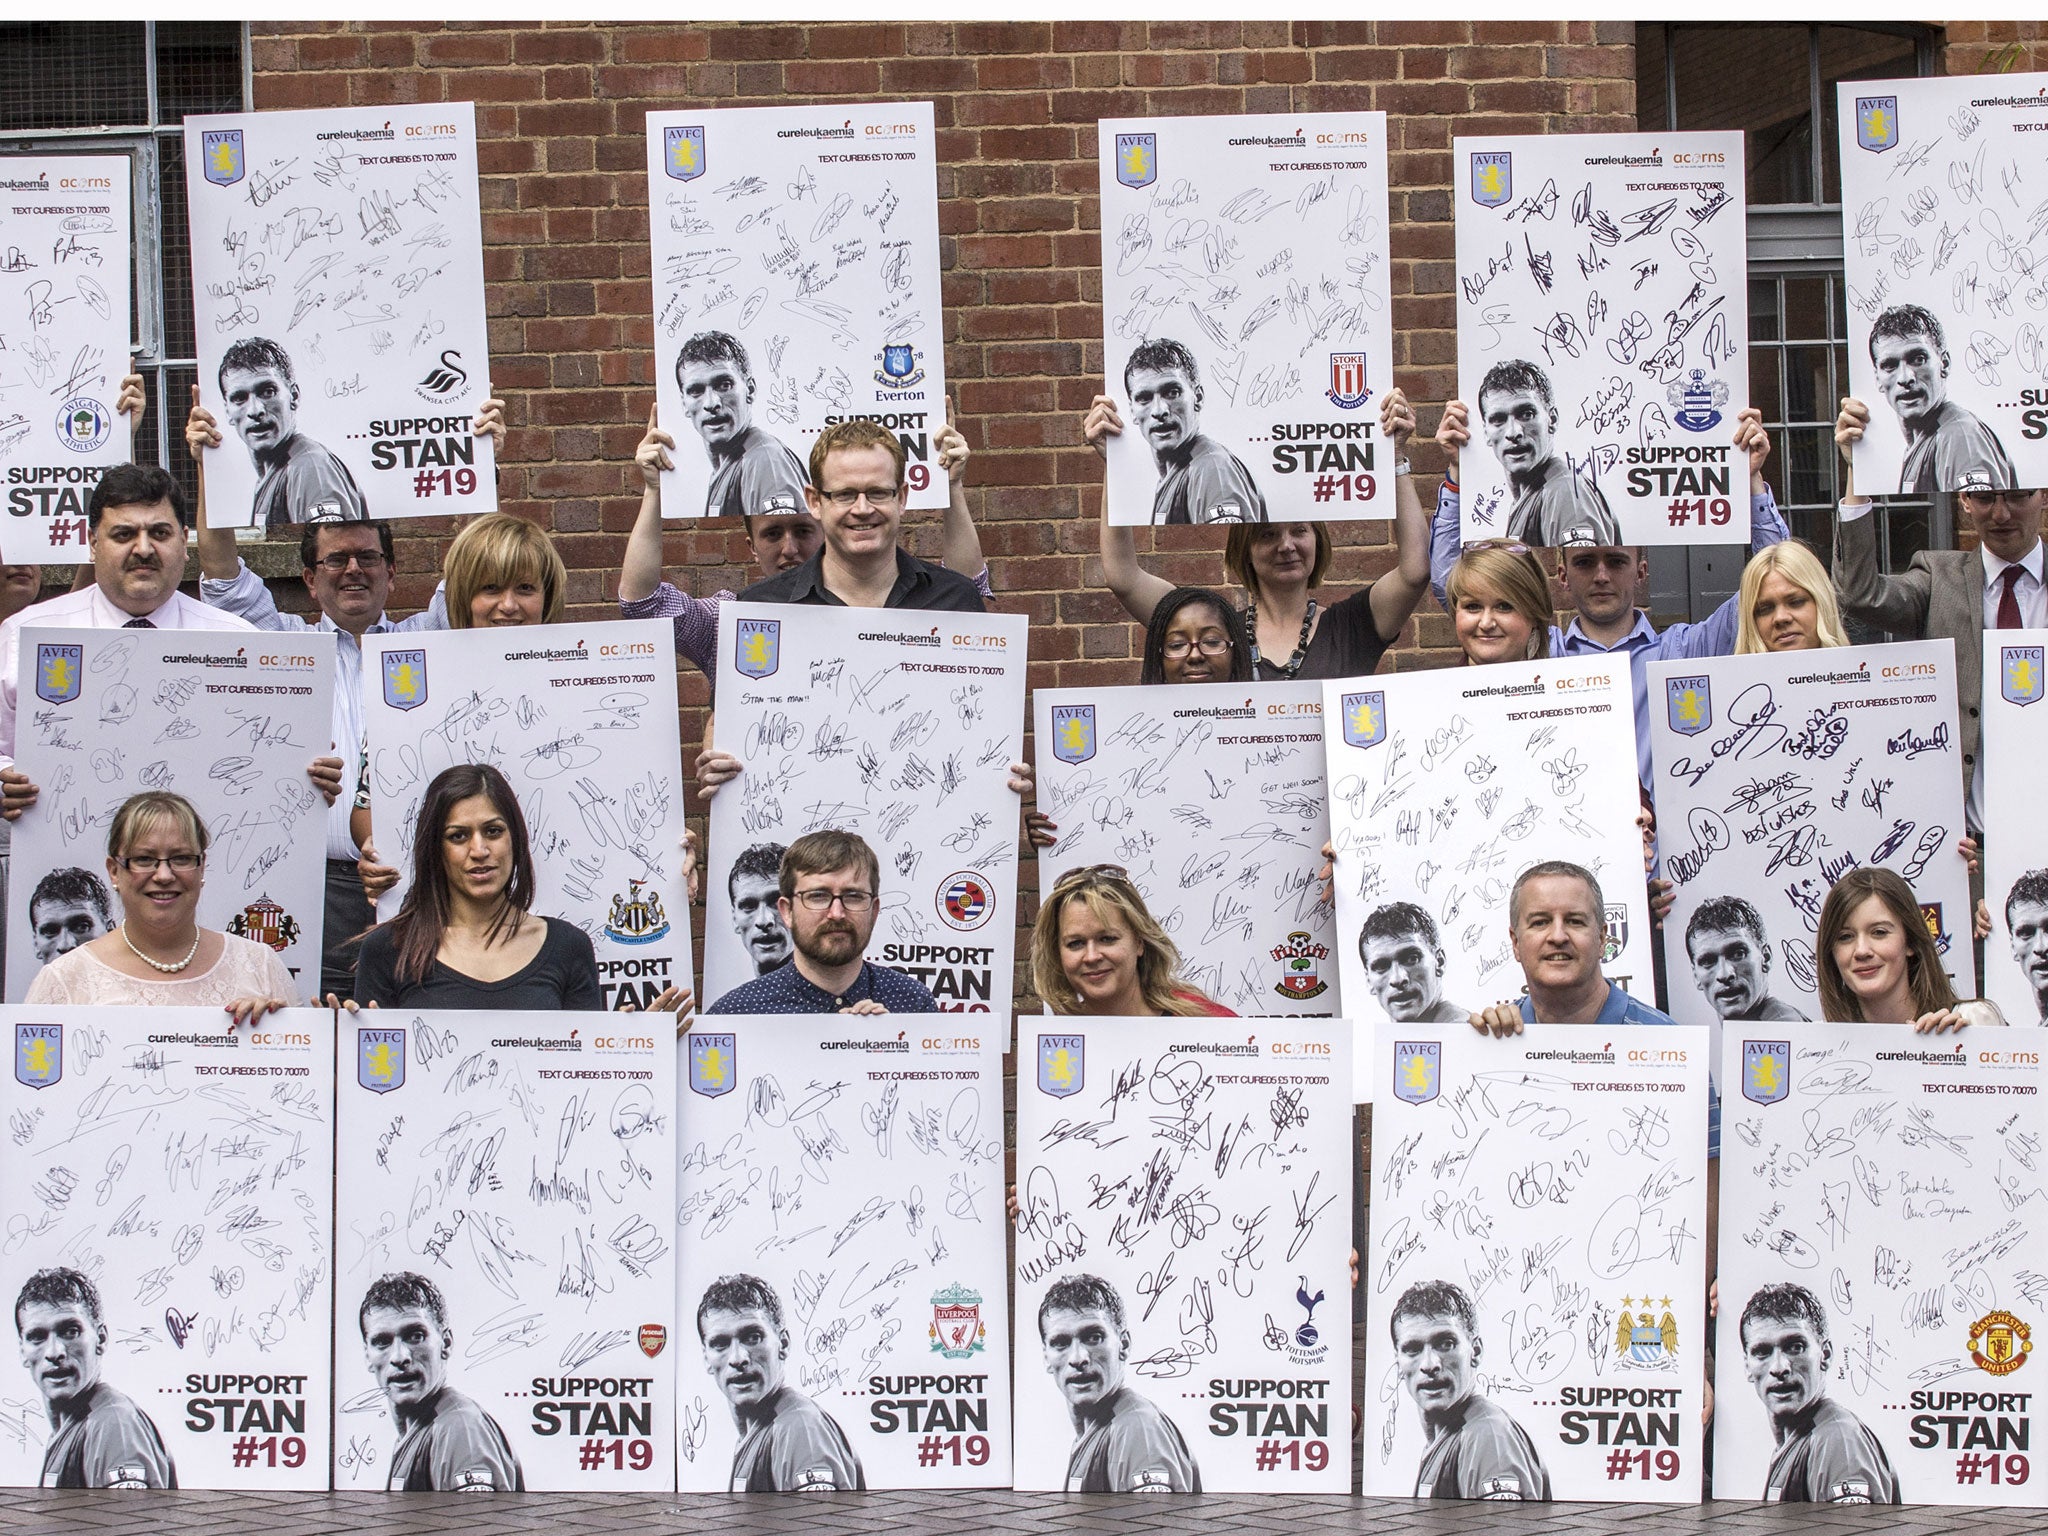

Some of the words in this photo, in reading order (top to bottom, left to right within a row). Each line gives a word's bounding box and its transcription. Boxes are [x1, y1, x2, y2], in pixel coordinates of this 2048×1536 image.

[1860, 99, 1893, 110] AVFC
[206, 132, 239, 143] AVFC
[316, 126, 395, 141] cureleukaemia
[668, 129, 701, 139] AVFC
[777, 125, 855, 138] cureleukaemia
[1120, 136, 1152, 146] AVFC
[1228, 133, 1306, 146] cureleukaemia
[359, 157, 378, 165] TEXT
[411, 155, 422, 163] £5
[422, 154, 434, 162] TO
[435, 153, 457, 161] 70070
[1332, 162, 1344, 170] TO
[1345, 161, 1367, 169] 70070
[1475, 155, 1508, 165] AVFC
[1585, 153, 1663, 165] cureleukaemia
[874, 353, 883, 361] 18
[913, 352, 924, 361] 78
[414, 387, 443, 404] SWANSEA
[445, 395, 460, 404] CITY
[460, 385, 472, 397] AFC
[875, 390, 925, 401] Everton
[65, 400, 101, 412] WIGAN
[1342, 396, 1367, 408] POTTERS
[64, 437, 102, 450] ATHLETIC
[370, 436, 474, 471] STAN
[1271, 442, 1375, 474] STAN
[413, 467, 477, 498] #19
[1313, 473, 1377, 502] #19
[1626, 466, 1730, 497] STAN
[1668, 498, 1732, 526] #19
[49, 519, 87, 546] #1
[741, 622, 776, 633] AVFC
[858, 629, 941, 644] cureleukaemia
[42, 647, 78, 658] AVFC
[162, 651, 248, 665] cureleukaemia
[386, 652, 422, 664] AVFC
[504, 645, 589, 661] cureleukaemia
[2006, 649, 2040, 660] AVFC
[1787, 667, 1871, 685] cureleukaemia
[1462, 680, 1545, 698] cureleukaemia
[1670, 678, 1706, 691] AVFC
[1346, 694, 1381, 706] AVFC
[1056, 708, 1091, 719] AVFC
[1173, 704, 1256, 718] cureleukaemia
[1217, 737, 1238, 745] TEXT
[1274, 735, 1285, 743] £5
[1285, 735, 1297, 743] TO
[1298, 734, 1322, 742] 70070
[1261, 782, 1278, 794] GET
[938, 877, 956, 906] READING
[956, 874, 987, 889] FOOTBALL
[596, 957, 673, 979] PPORT
[888, 966, 992, 1001] TAN
[600, 980, 672, 1011] TAN
[21, 1028, 58, 1039] AVFC
[148, 1031, 239, 1044] cureleukaemia
[363, 1032, 401, 1043] AVFC
[491, 1035, 582, 1048] cureleukaemia
[693, 1036, 731, 1047] AVFC
[819, 1037, 910, 1050] cureleukaemia
[1043, 1038, 1080, 1049] AVFC
[1169, 1041, 1259, 1053] cureleukaemia
[1399, 1045, 1436, 1055] AVFC
[1525, 1048, 1615, 1061] cureleukaemia
[1748, 1044, 1786, 1055] AVFC
[1876, 1048, 1967, 1062] cureleukaemia
[867, 1072, 890, 1080] TEXT
[928, 1072, 940, 1080] £5
[940, 1072, 954, 1080] TO
[955, 1071, 980, 1080] 70070
[1923, 1084, 1945, 1093] TEXT
[1984, 1086, 1996, 1094] £5
[1997, 1086, 2010, 1095] TO
[2012, 1086, 2037, 1095] 70070
[938, 1310, 976, 1318] LIVERPOOL
[1974, 1315, 2027, 1337] MANCHESTER
[1285, 1344, 1329, 1356] TOTTENHAM
[1289, 1355, 1325, 1365] HOTSPUR
[1981, 1360, 2018, 1372] UNITED
[185, 1398, 305, 1433] STAN
[531, 1402, 652, 1436] STAN
[869, 1398, 988, 1434] STAN
[1208, 1403, 1328, 1437] STAN
[1559, 1411, 1679, 1446] STAN
[1909, 1415, 2029, 1451] STAN
[232, 1436, 306, 1468] #19
[579, 1439, 653, 1471] #19
[917, 1434, 991, 1467] #19
[1256, 1440, 1329, 1471] #19
[1606, 1449, 1680, 1481] #19
[1956, 1453, 2030, 1486] #19
